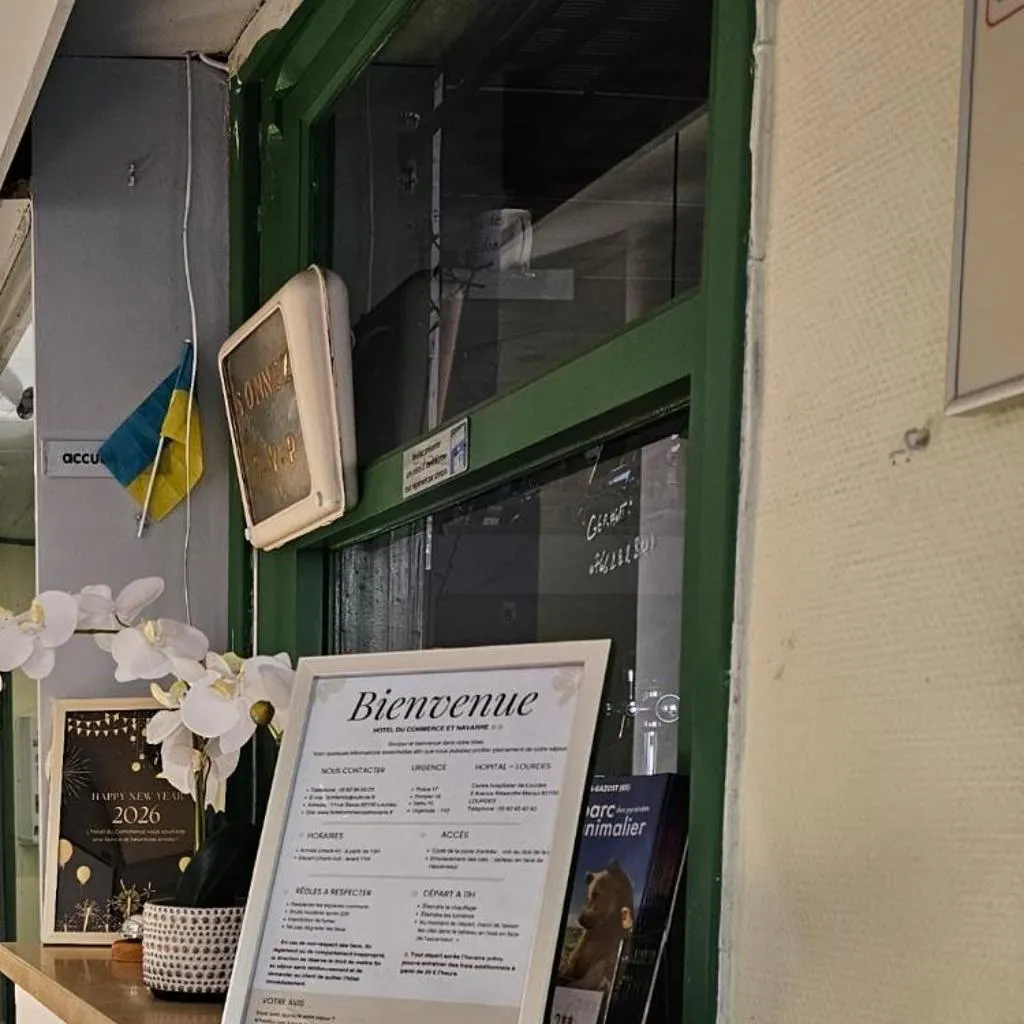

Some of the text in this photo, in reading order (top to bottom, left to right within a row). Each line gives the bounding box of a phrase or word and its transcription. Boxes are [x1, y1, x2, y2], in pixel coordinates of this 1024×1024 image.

[62, 452, 105, 464] accu
[347, 688, 539, 722] Bienvenue
[91, 792, 124, 801] HAPPY
[129, 792, 152, 801] NEW
[112, 806, 161, 824] 2026
[585, 816, 646, 837] nimalier
[307, 832, 344, 840] HORAIRES
[262, 997, 285, 1005] VOTRE
